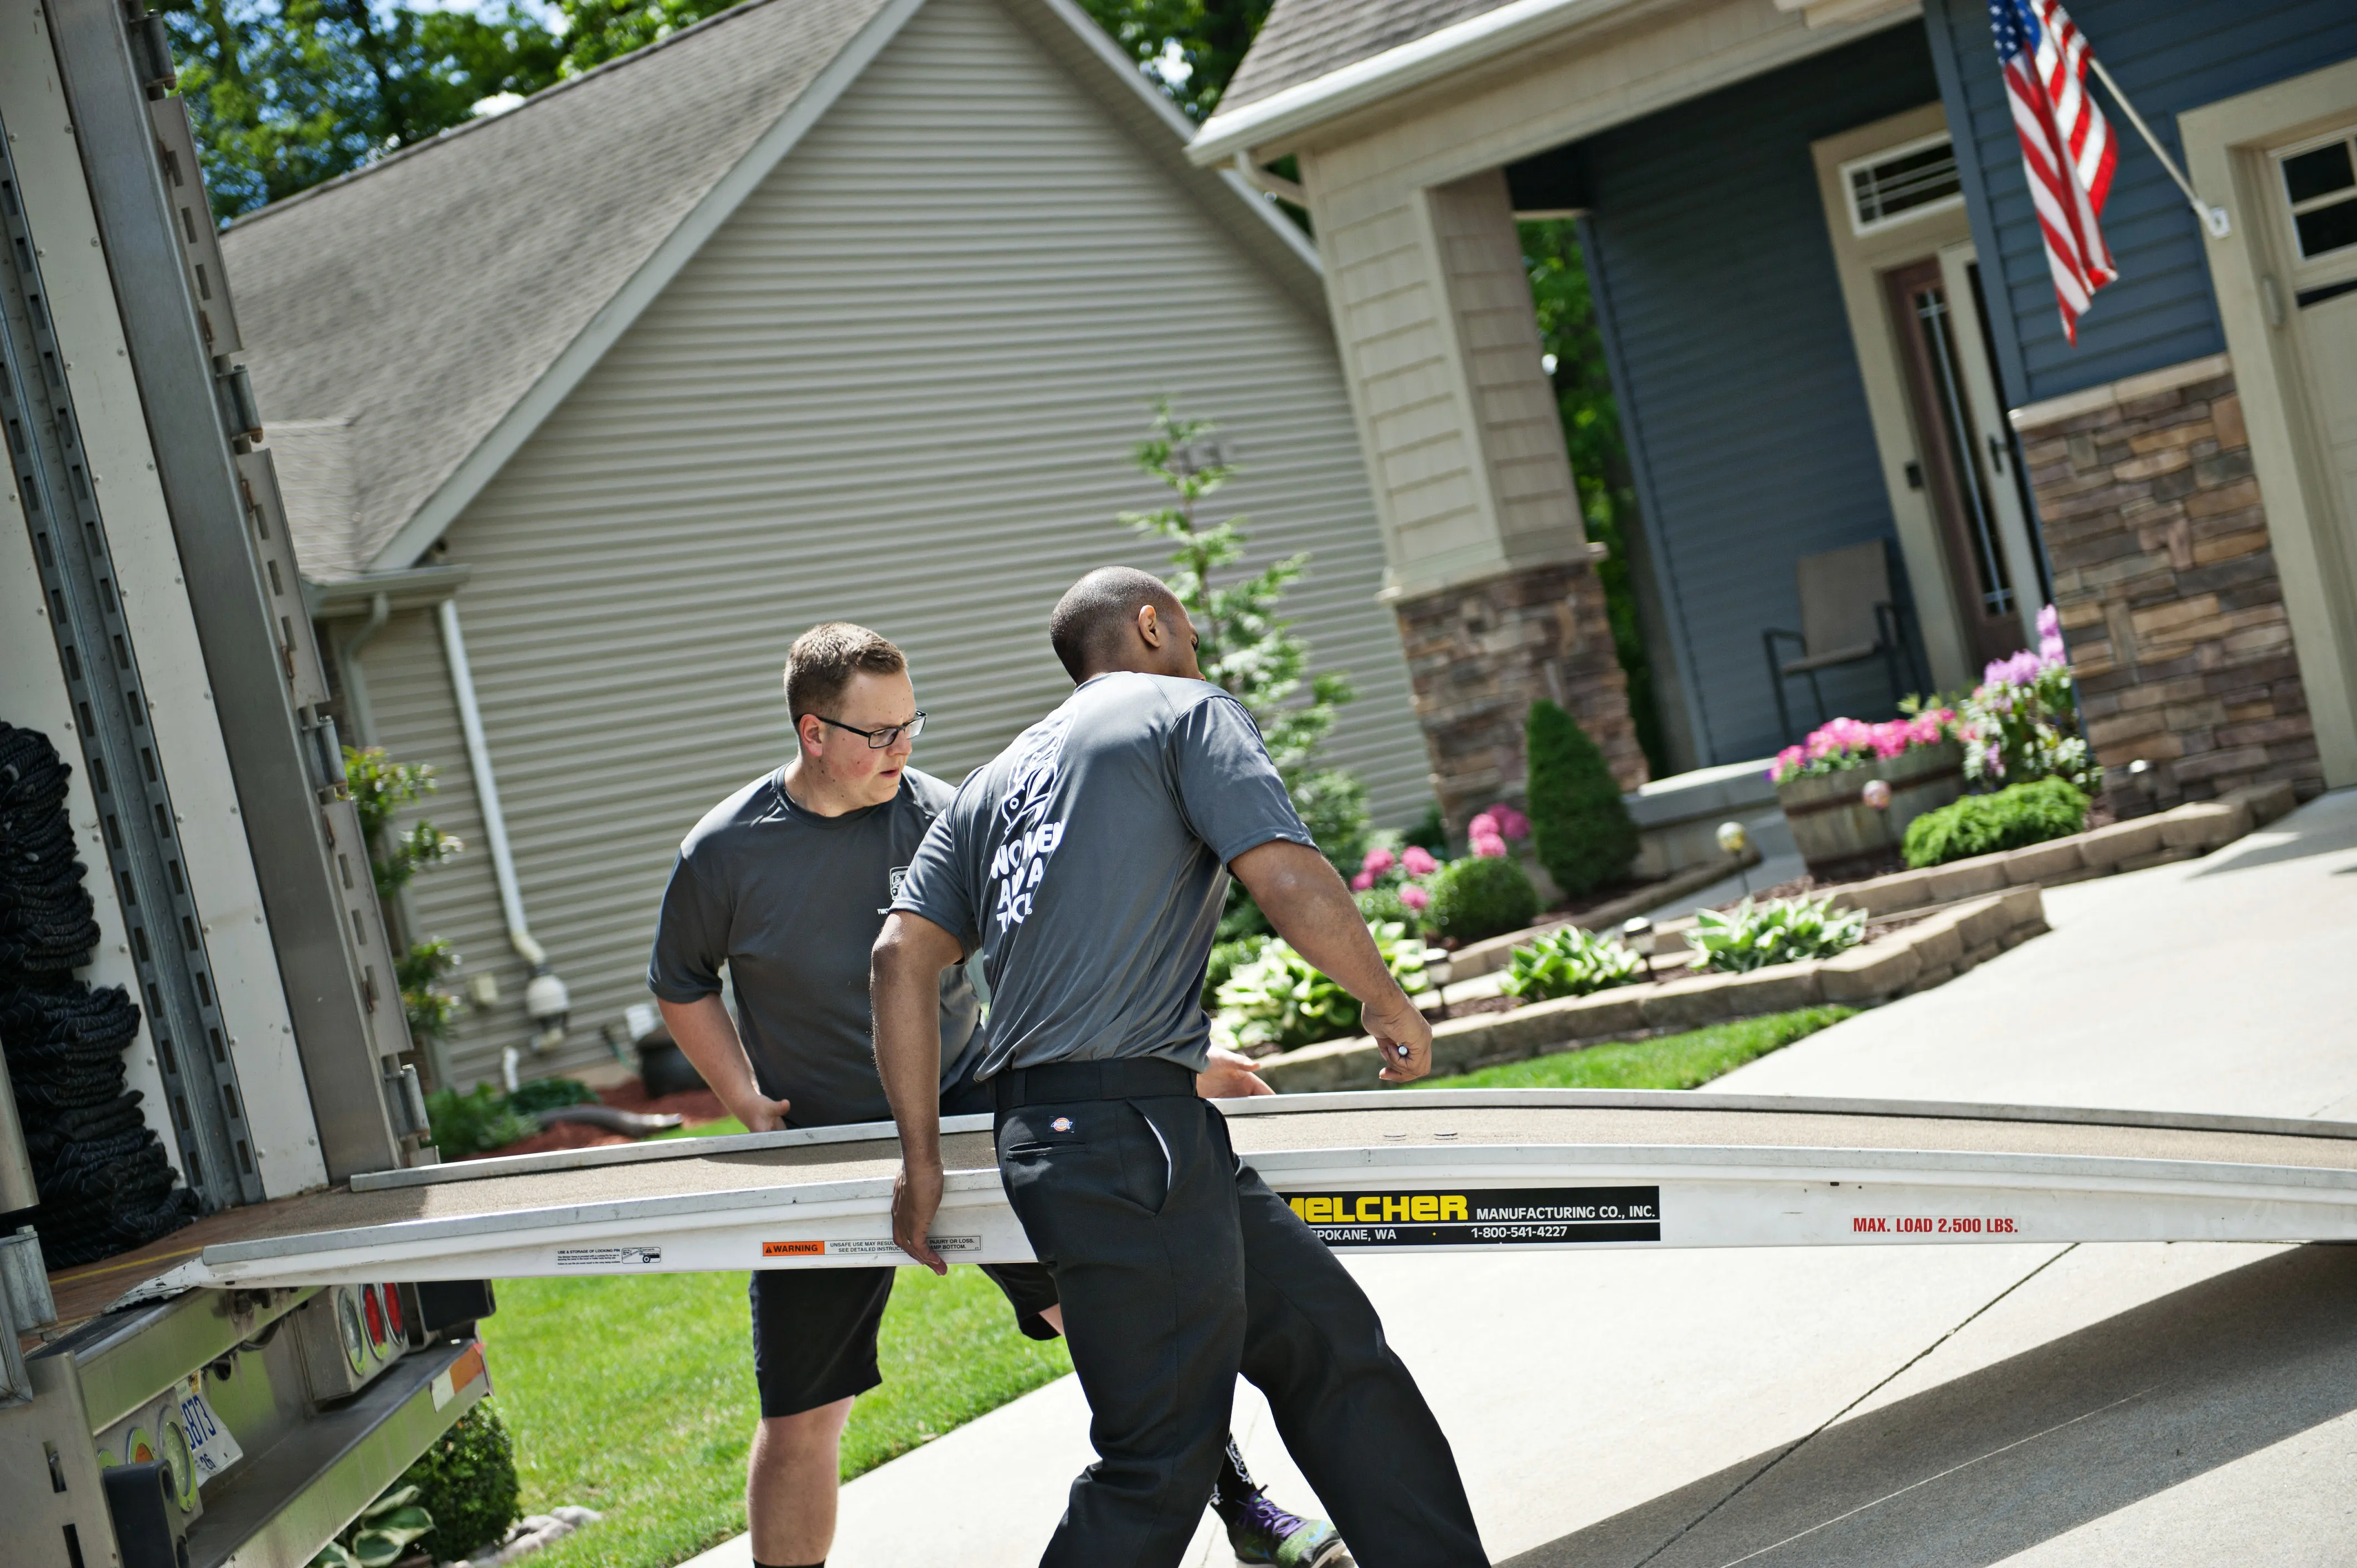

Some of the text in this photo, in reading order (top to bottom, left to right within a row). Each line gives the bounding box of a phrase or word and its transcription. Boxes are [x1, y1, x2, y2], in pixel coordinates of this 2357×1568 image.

[1026, 857, 1044, 888] A
[1476, 1206, 1596, 1220] MANUFACTURING
[1599, 1205, 1625, 1220] CO.,
[1629, 1205, 1655, 1218] INC.
[1375, 1228, 1397, 1241] WA
[1470, 1225, 1568, 1239] 1-800-541-4227
[1853, 1218, 2018, 1233] MAX. LOAD 2,500 LBS.
